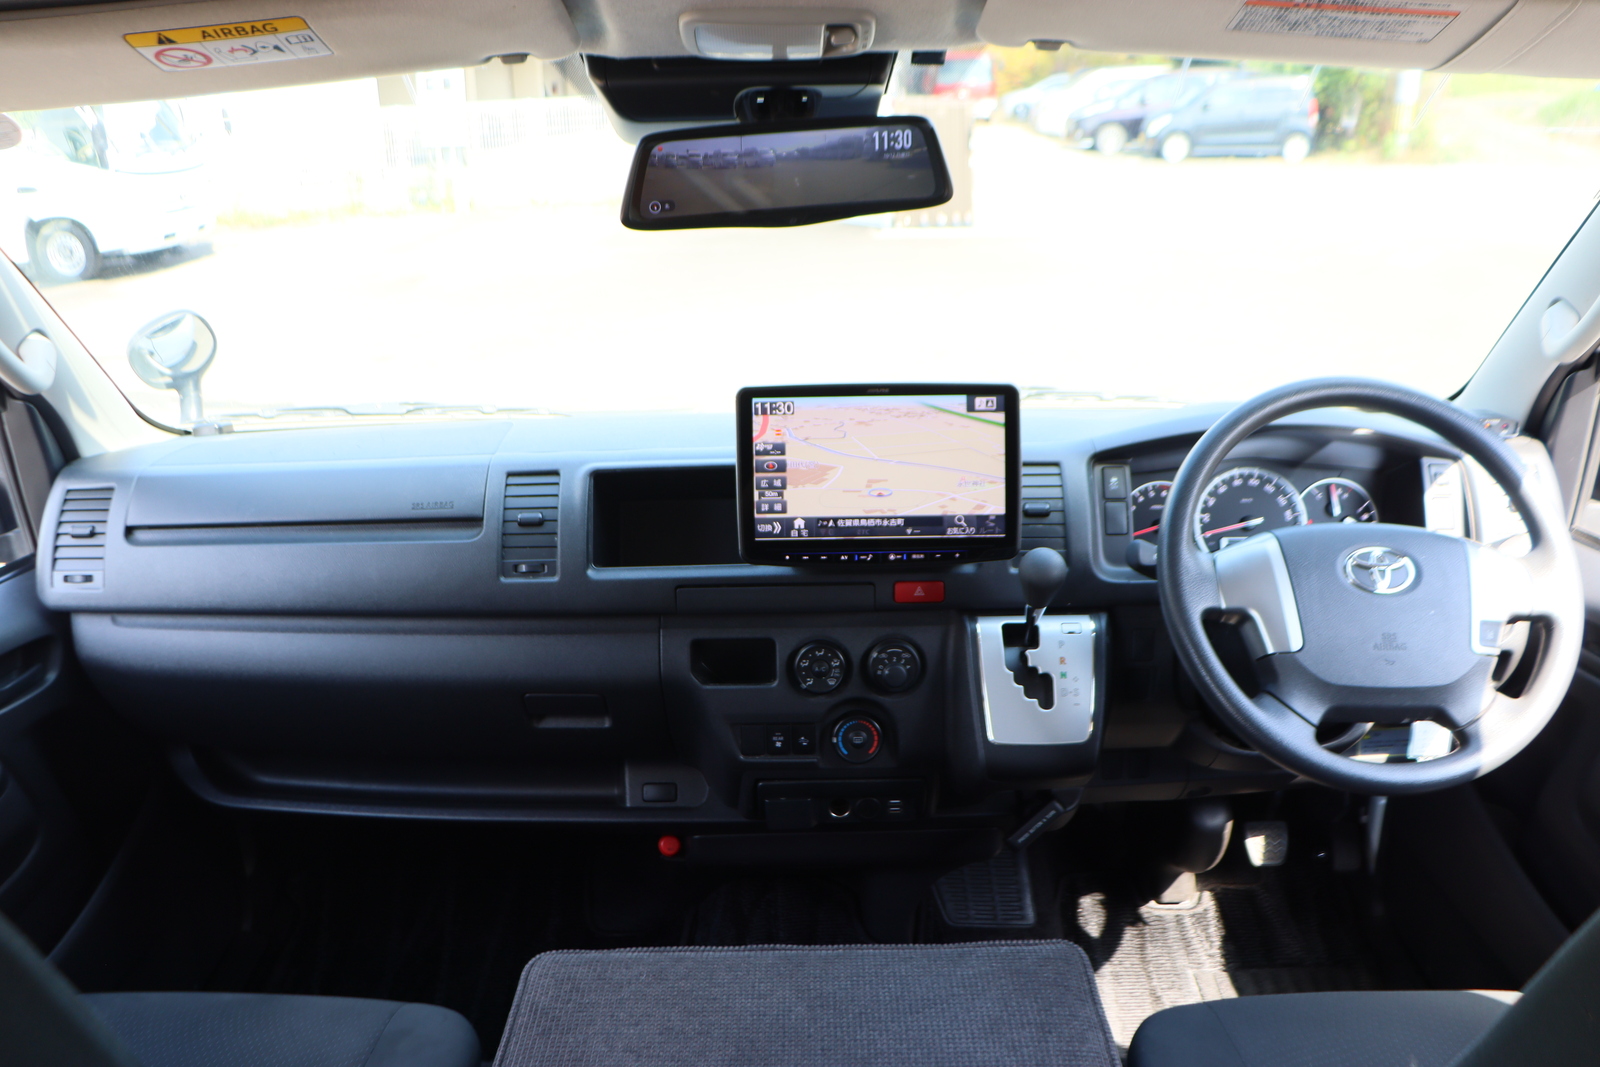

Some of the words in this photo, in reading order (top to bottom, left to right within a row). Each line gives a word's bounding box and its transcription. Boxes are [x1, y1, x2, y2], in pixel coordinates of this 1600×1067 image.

[201, 23, 278, 40] AIRBAG
[873, 129, 912, 151] 11:30
[755, 401, 794, 415] 11:30
[946, 526, 976, 535] お気に入り
[1059, 656, 1067, 665] R
[1060, 671, 1067, 680] N
